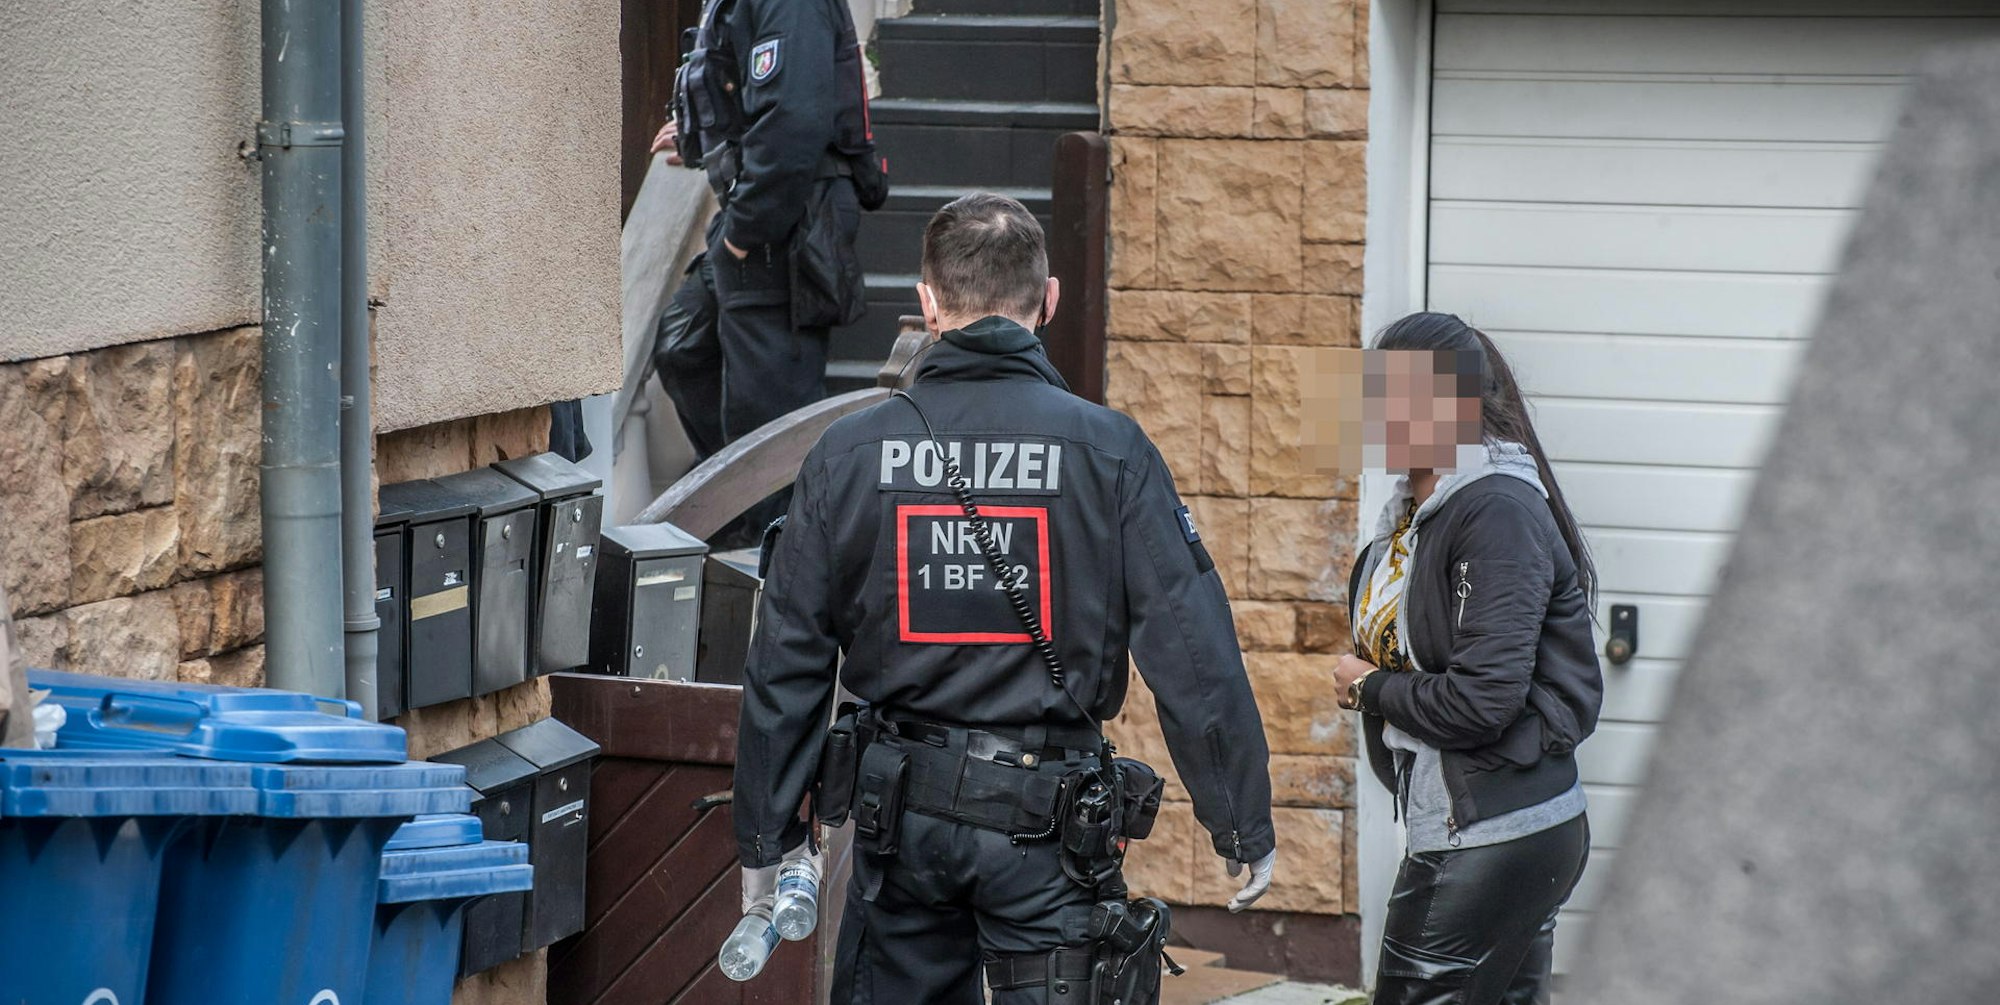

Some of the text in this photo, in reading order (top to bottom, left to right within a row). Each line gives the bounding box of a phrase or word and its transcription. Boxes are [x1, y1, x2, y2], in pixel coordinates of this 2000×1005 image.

[880, 439, 1061, 490] POLIZEI
[931, 521, 1013, 555] NRW
[918, 564, 930, 590] 1
[944, 564, 985, 590] BF
